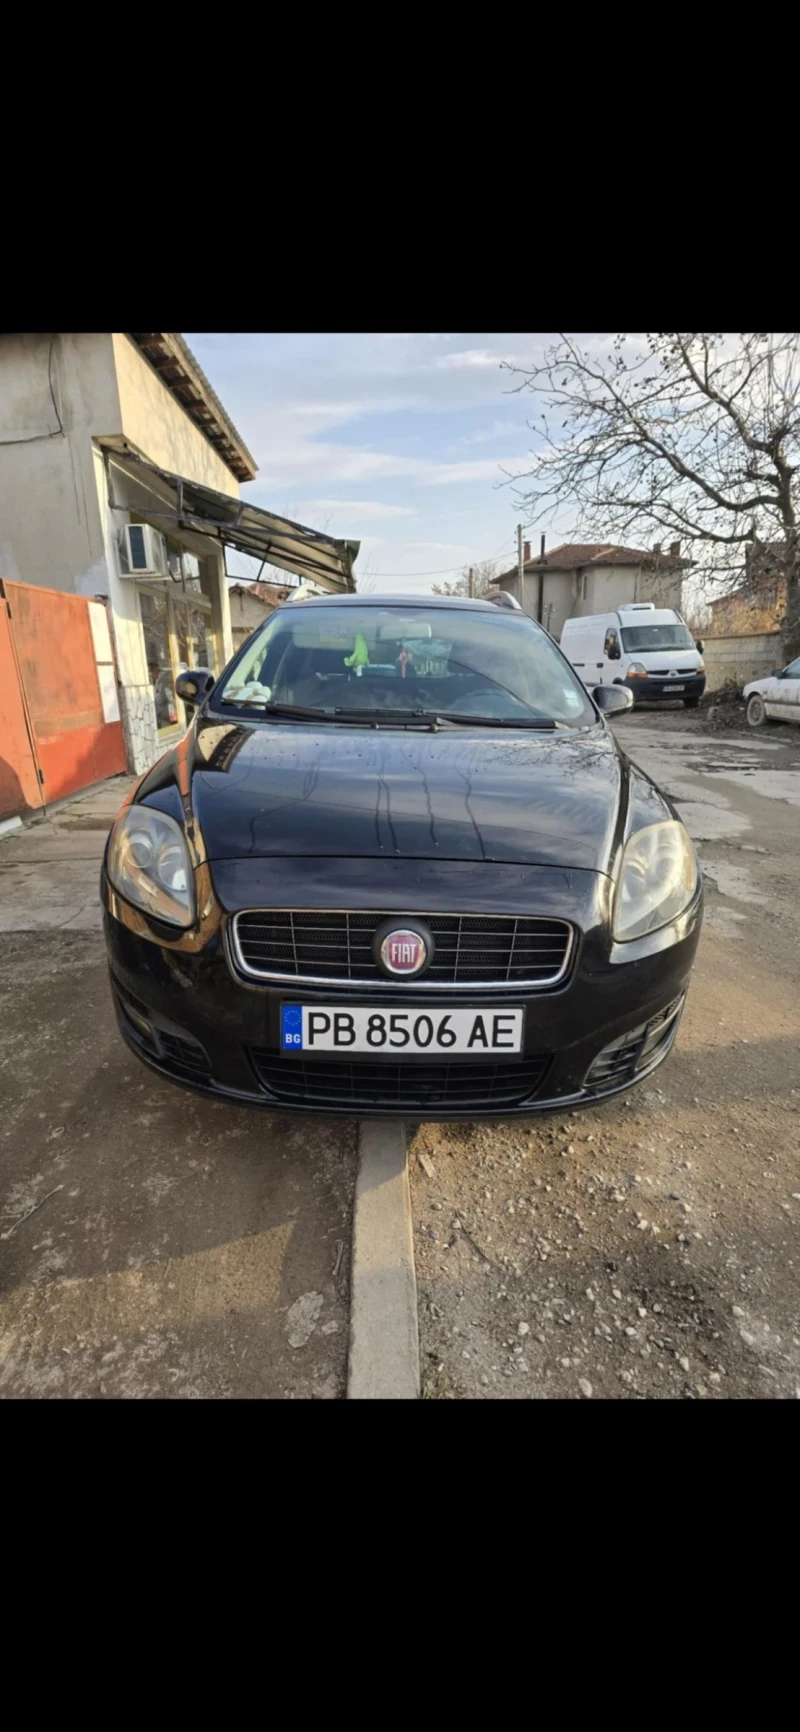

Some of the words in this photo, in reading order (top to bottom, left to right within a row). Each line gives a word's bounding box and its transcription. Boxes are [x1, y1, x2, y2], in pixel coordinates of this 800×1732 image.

[391, 943, 417, 963] FIAT
[285, 1033, 301, 1044] BG
[308, 1012, 356, 1046] PB
[366, 1014, 457, 1048] 8506
[467, 1015, 516, 1048] AE
